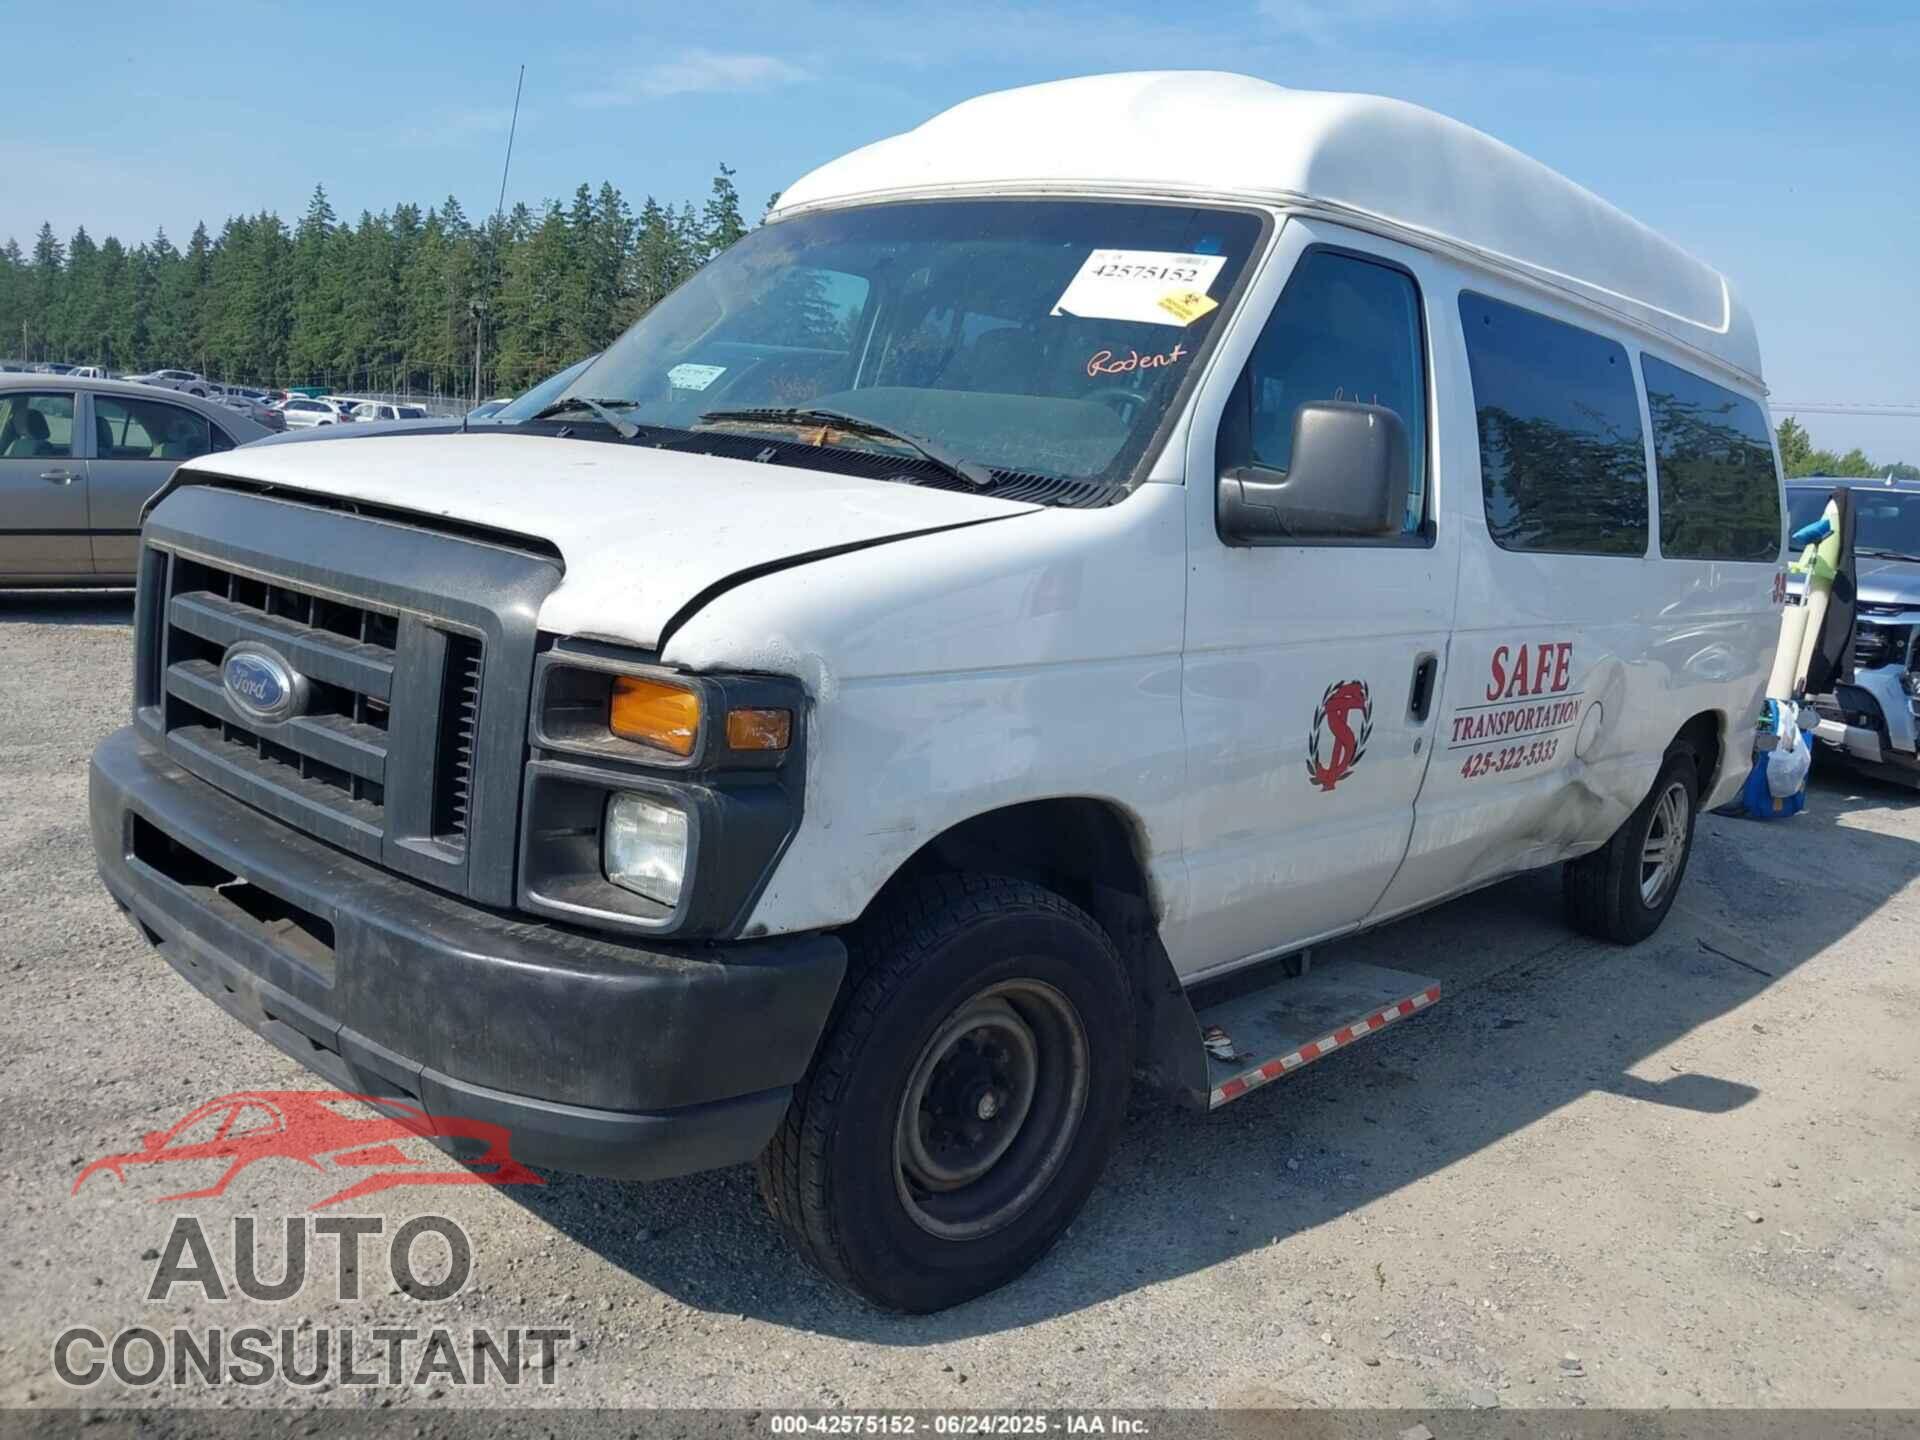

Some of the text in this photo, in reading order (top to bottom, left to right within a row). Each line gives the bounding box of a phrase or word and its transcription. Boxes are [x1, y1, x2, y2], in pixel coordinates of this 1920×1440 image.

[1092, 264, 1198, 282] 42575152
[1087, 344, 1187, 376] Rodent
[230, 664, 267, 701] Ford
[1486, 642, 1573, 701] SAFE
[1451, 699, 1583, 743] TRANSPORTATION
[1460, 737, 1559, 779] 425-322-5333
